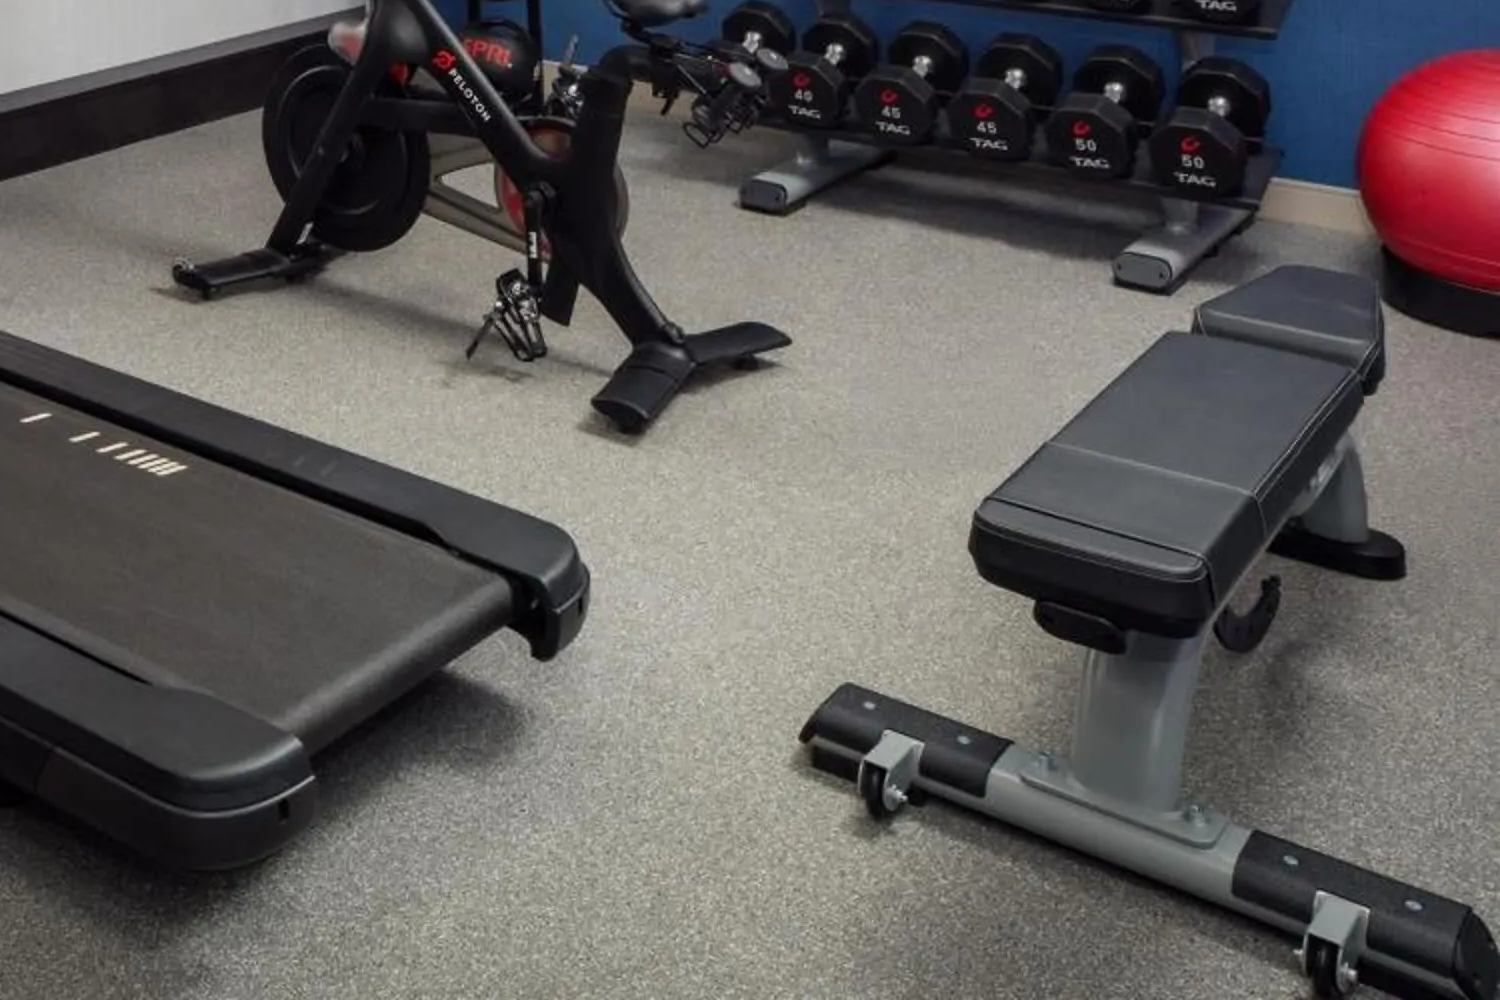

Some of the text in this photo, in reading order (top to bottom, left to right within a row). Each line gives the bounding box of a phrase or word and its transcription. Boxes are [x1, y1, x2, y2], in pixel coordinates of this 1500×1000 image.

[1195, 0, 1237, 11] TAG
[448, 67, 491, 122] PELOTON
[788, 105, 821, 119] TAG
[881, 105, 901, 119] 45
[875, 121, 911, 136] TAG
[976, 121, 997, 135] 45
[970, 137, 1008, 151] TAG
[1075, 137, 1097, 152] 50
[1071, 156, 1110, 169] TAG
[1181, 154, 1205, 169] 50
[1173, 171, 1217, 188] TAG
